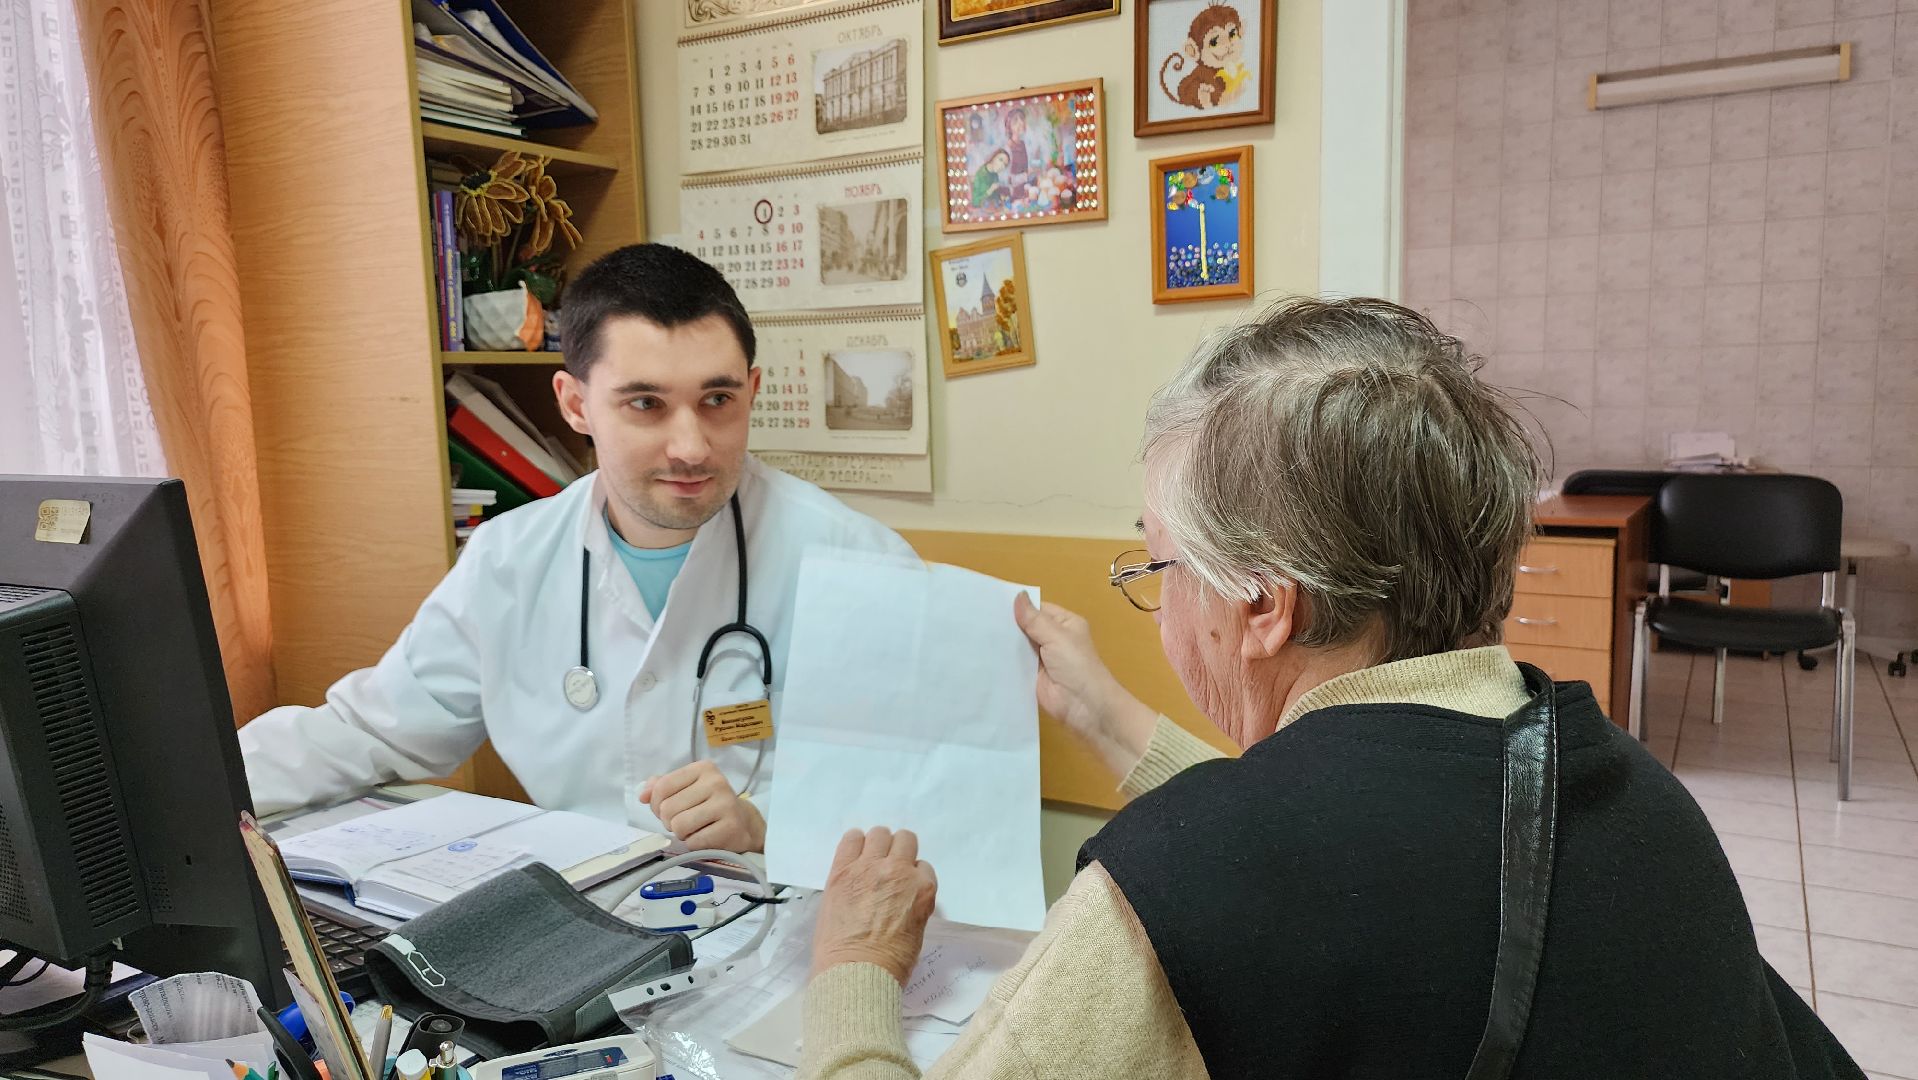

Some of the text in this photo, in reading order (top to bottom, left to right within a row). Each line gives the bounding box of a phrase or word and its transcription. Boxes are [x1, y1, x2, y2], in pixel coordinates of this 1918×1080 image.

[709, 53, 795, 79] 1 2 3 4 5 6
[693, 71, 797, 98] 7 8 9 10 11 12 13
[690, 89, 799, 116] 14 15 16 17 18 19 20
[690, 107, 799, 133] 21 22 23 24 25 26 27
[690, 132, 751, 151] 28 29 30 31
[697, 221, 804, 241] 4 5 6 7 8 9 10
[697, 238, 803, 257] 11 12 13 14 15 16 17
[727, 260, 742, 273] 20
[745, 260, 756, 272] 21
[760, 259, 773, 271] 22
[775, 257, 789, 271] 23
[791, 257, 804, 270] 24
[745, 277, 758, 290] 28
[760, 276, 774, 289] 29
[775, 275, 790, 288] 30
[767, 366, 806, 378] 6 7 8
[766, 384, 778, 395] 13
[782, 383, 793, 395] 14
[797, 383, 809, 395] 15
[766, 400, 780, 412] 20
[783, 400, 794, 412] 21
[797, 400, 810, 412] 22
[751, 416, 810, 429] 26 27 28 29
